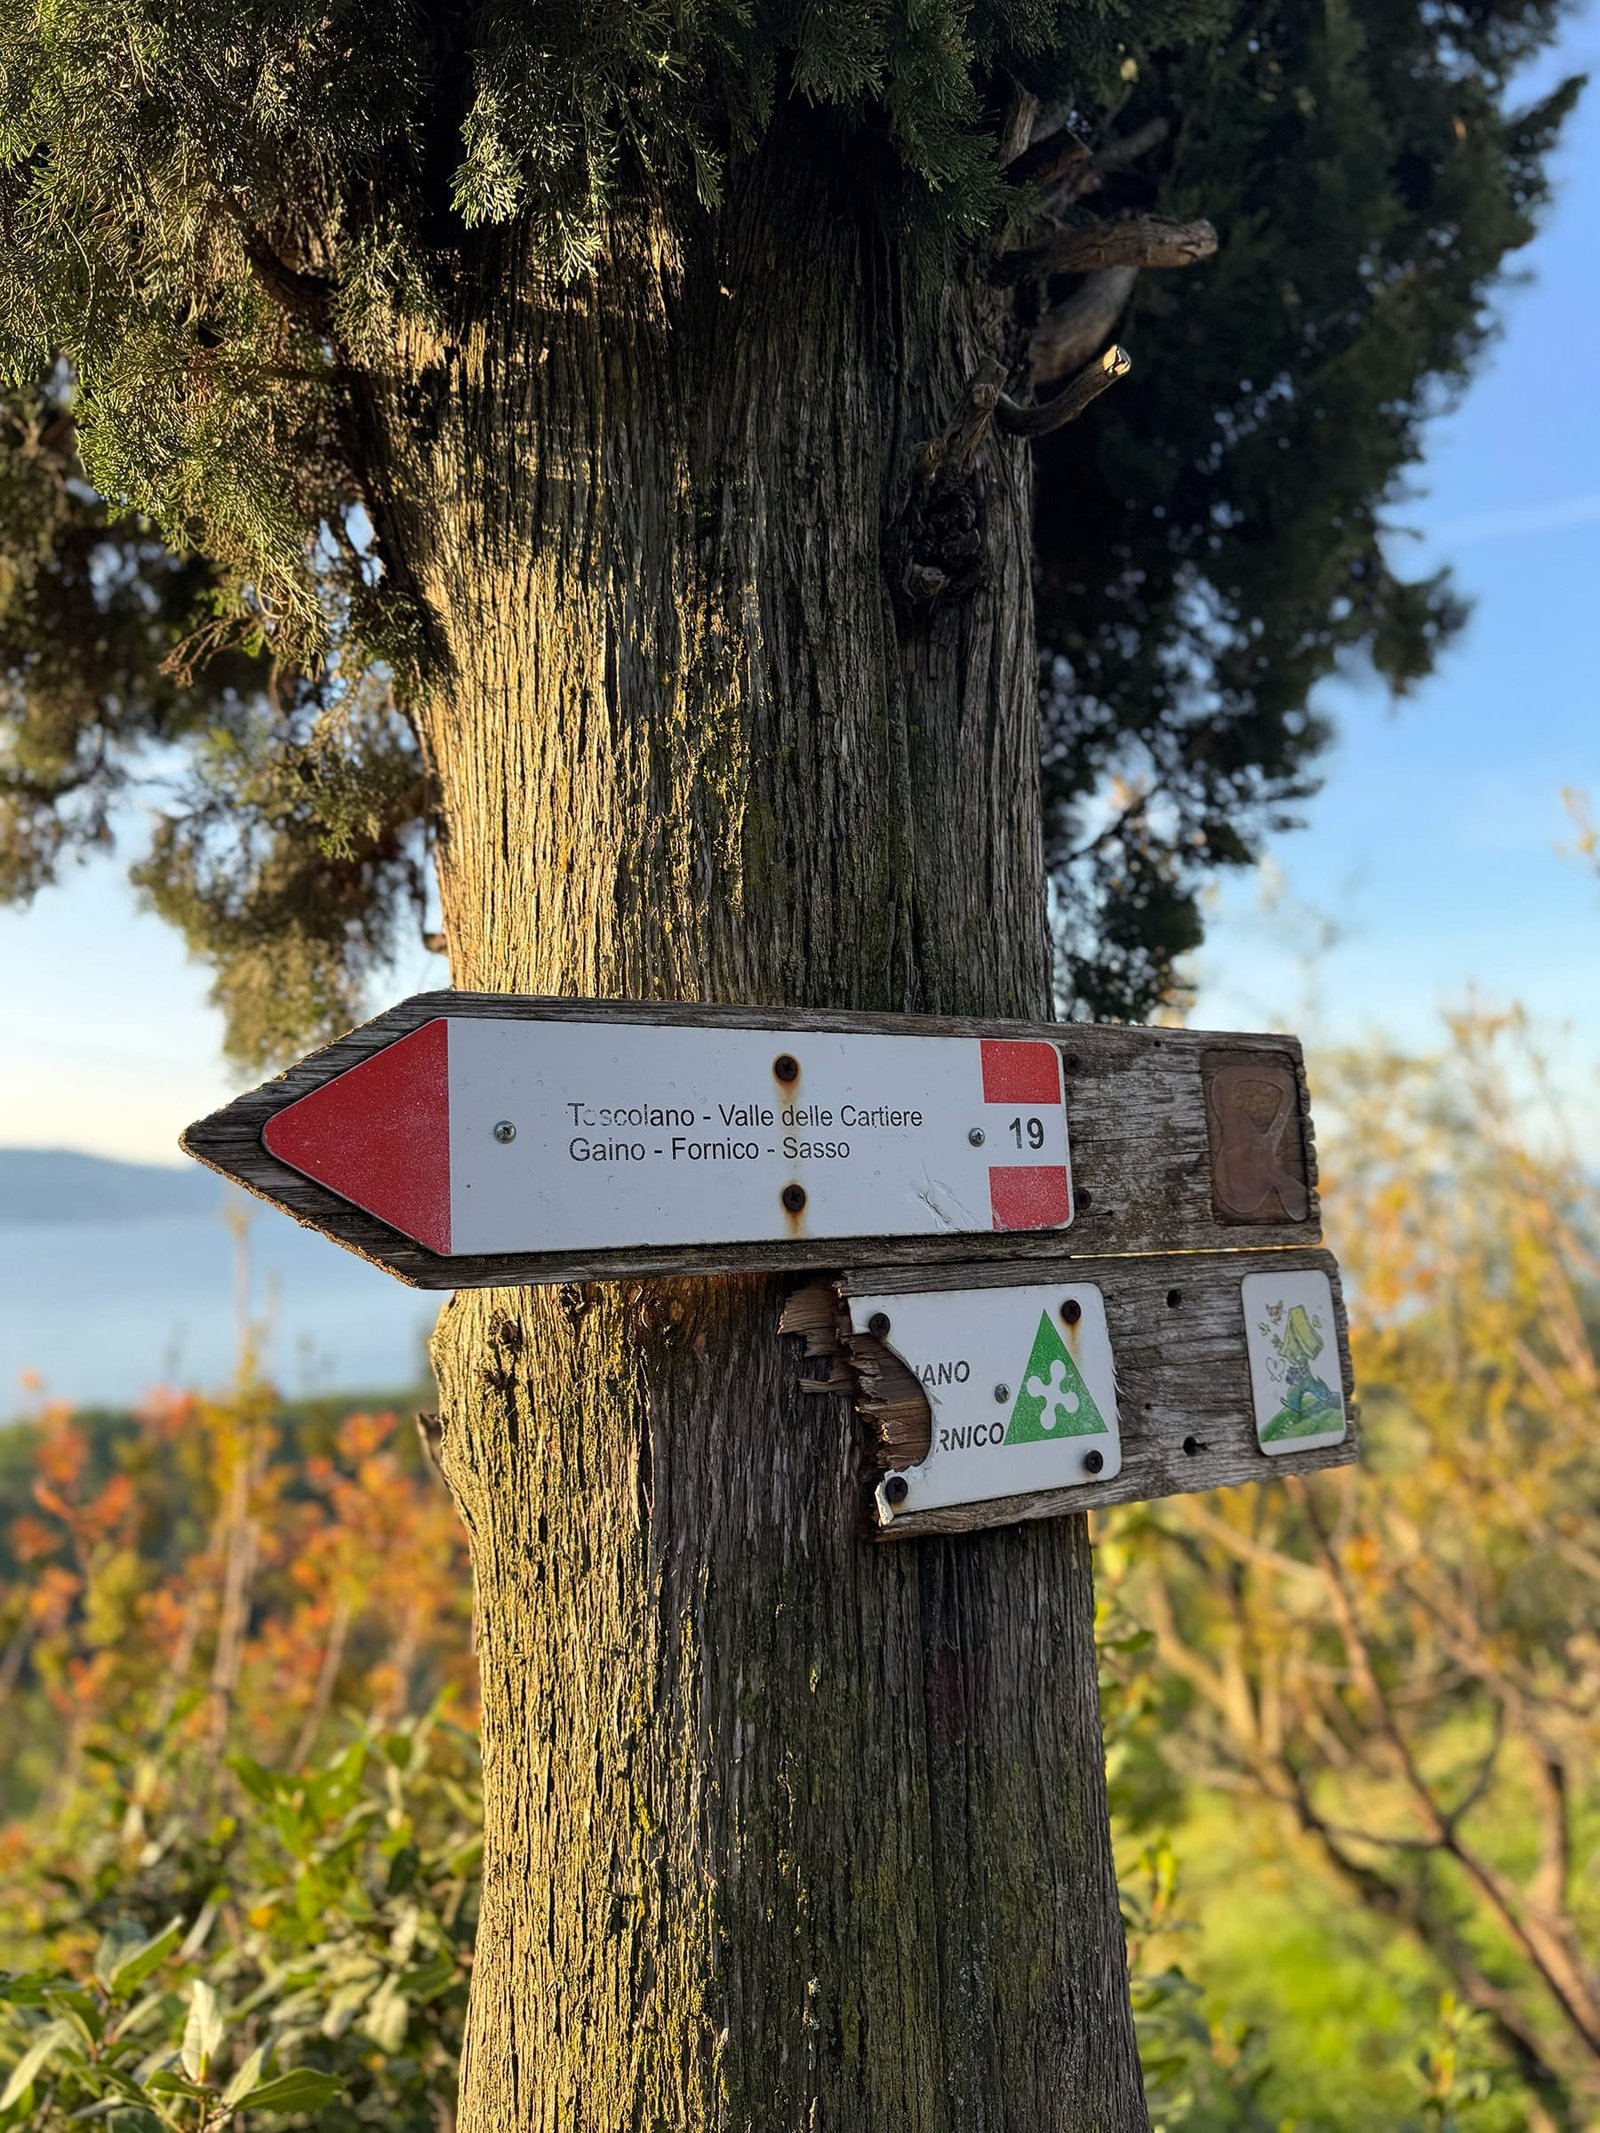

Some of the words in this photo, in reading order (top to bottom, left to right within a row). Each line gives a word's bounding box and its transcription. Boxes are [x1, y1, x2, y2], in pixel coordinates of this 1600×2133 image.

[718, 1103, 774, 1127] Valle
[781, 1104, 833, 1127] delle
[840, 1104, 923, 1127] Cartiere
[1009, 1117, 1045, 1150] 19
[569, 1136, 646, 1162] Gaino
[671, 1136, 760, 1160] Fornico
[782, 1136, 851, 1160] Sasso
